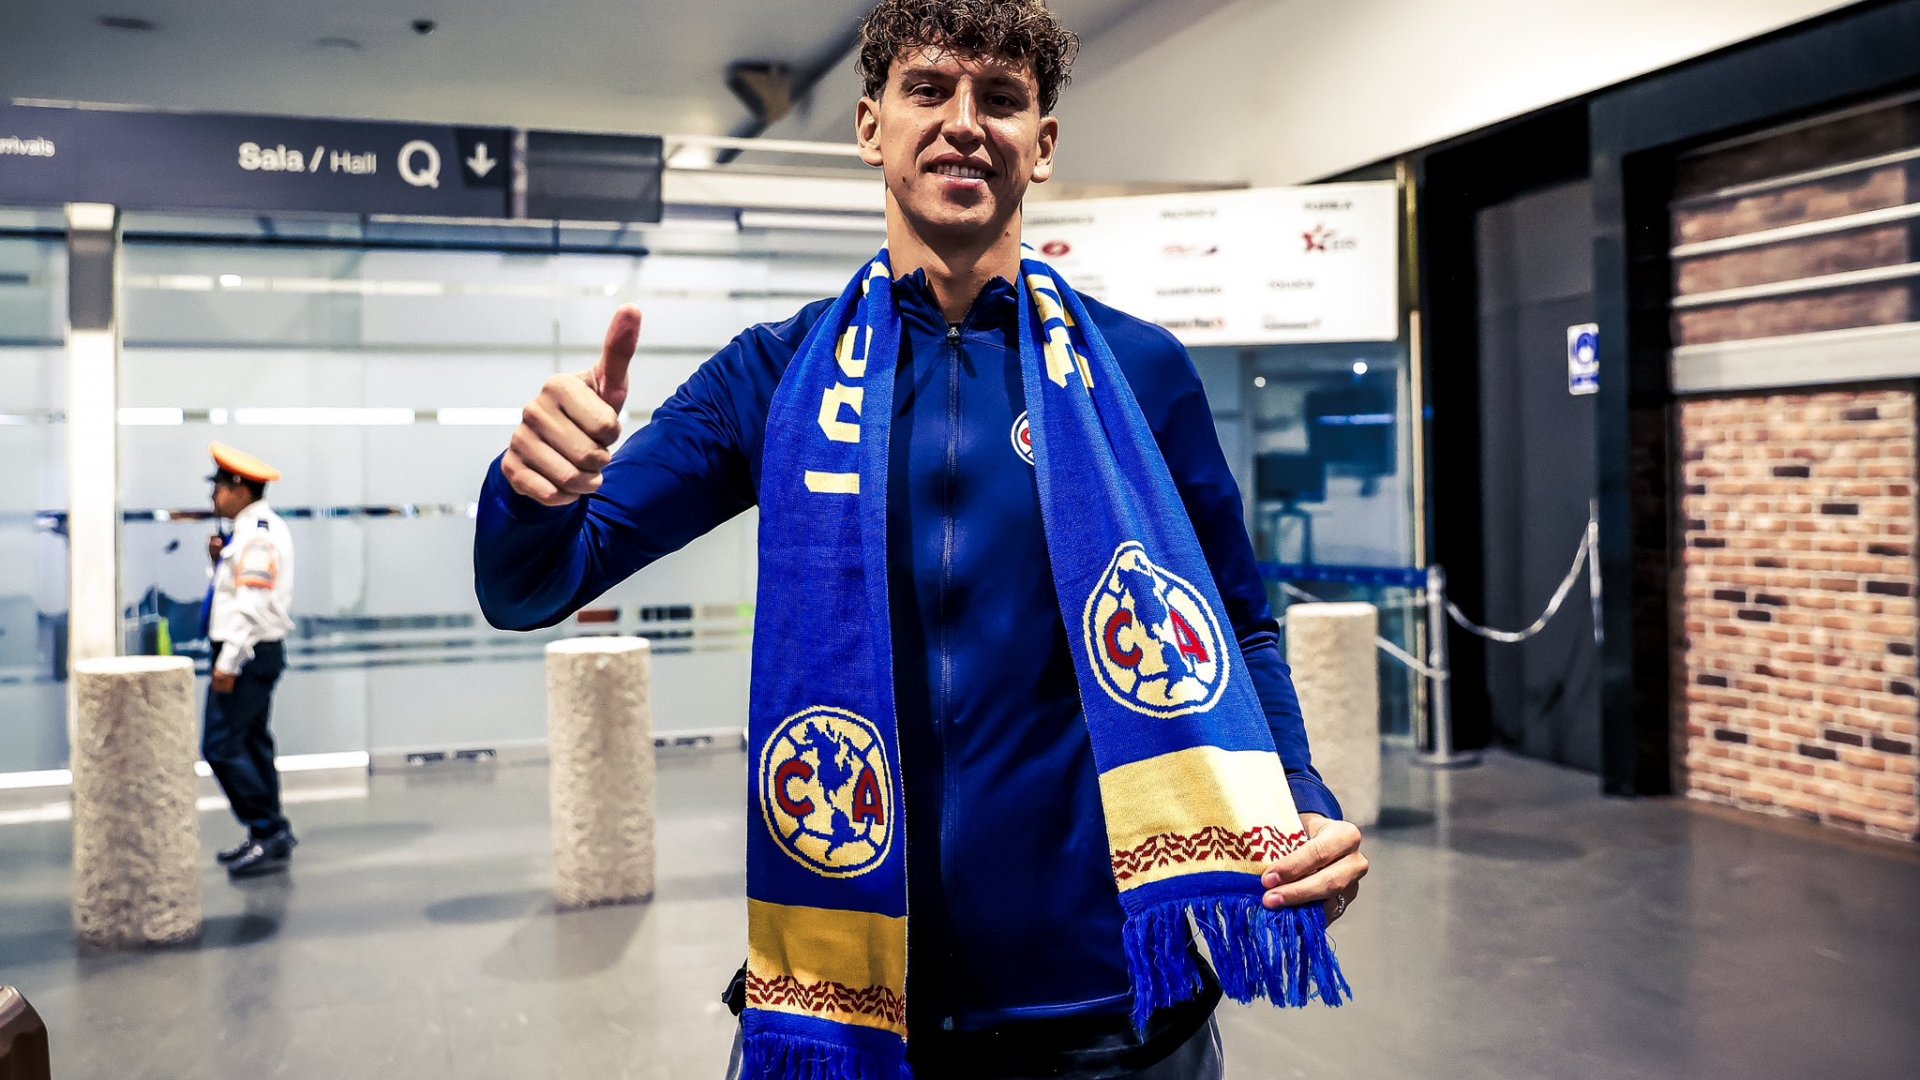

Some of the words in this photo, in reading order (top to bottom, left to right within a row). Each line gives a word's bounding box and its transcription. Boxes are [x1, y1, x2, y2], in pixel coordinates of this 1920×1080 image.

[238, 141, 304, 172] Sala
[309, 145, 325, 173] /
[330, 150, 377, 174] Hall
[397, 139, 441, 189] Q
